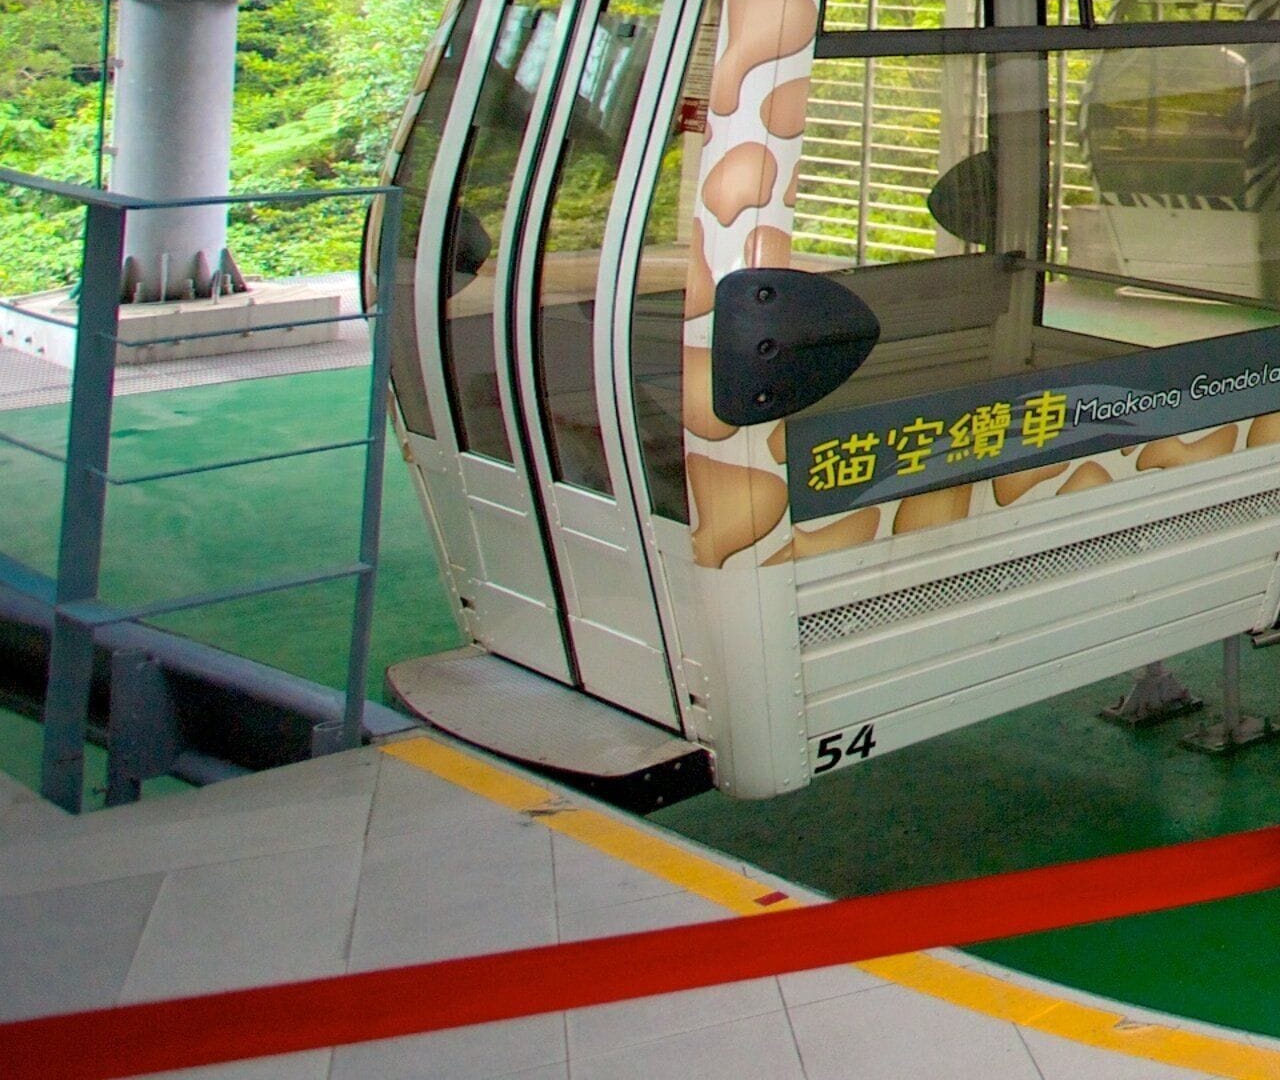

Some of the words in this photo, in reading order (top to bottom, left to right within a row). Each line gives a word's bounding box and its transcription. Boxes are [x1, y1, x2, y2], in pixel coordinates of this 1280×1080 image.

[1073, 389, 1181, 426] Maokong
[807, 390, 1068, 491] 貓空纜車
[814, 723, 877, 774] 54
